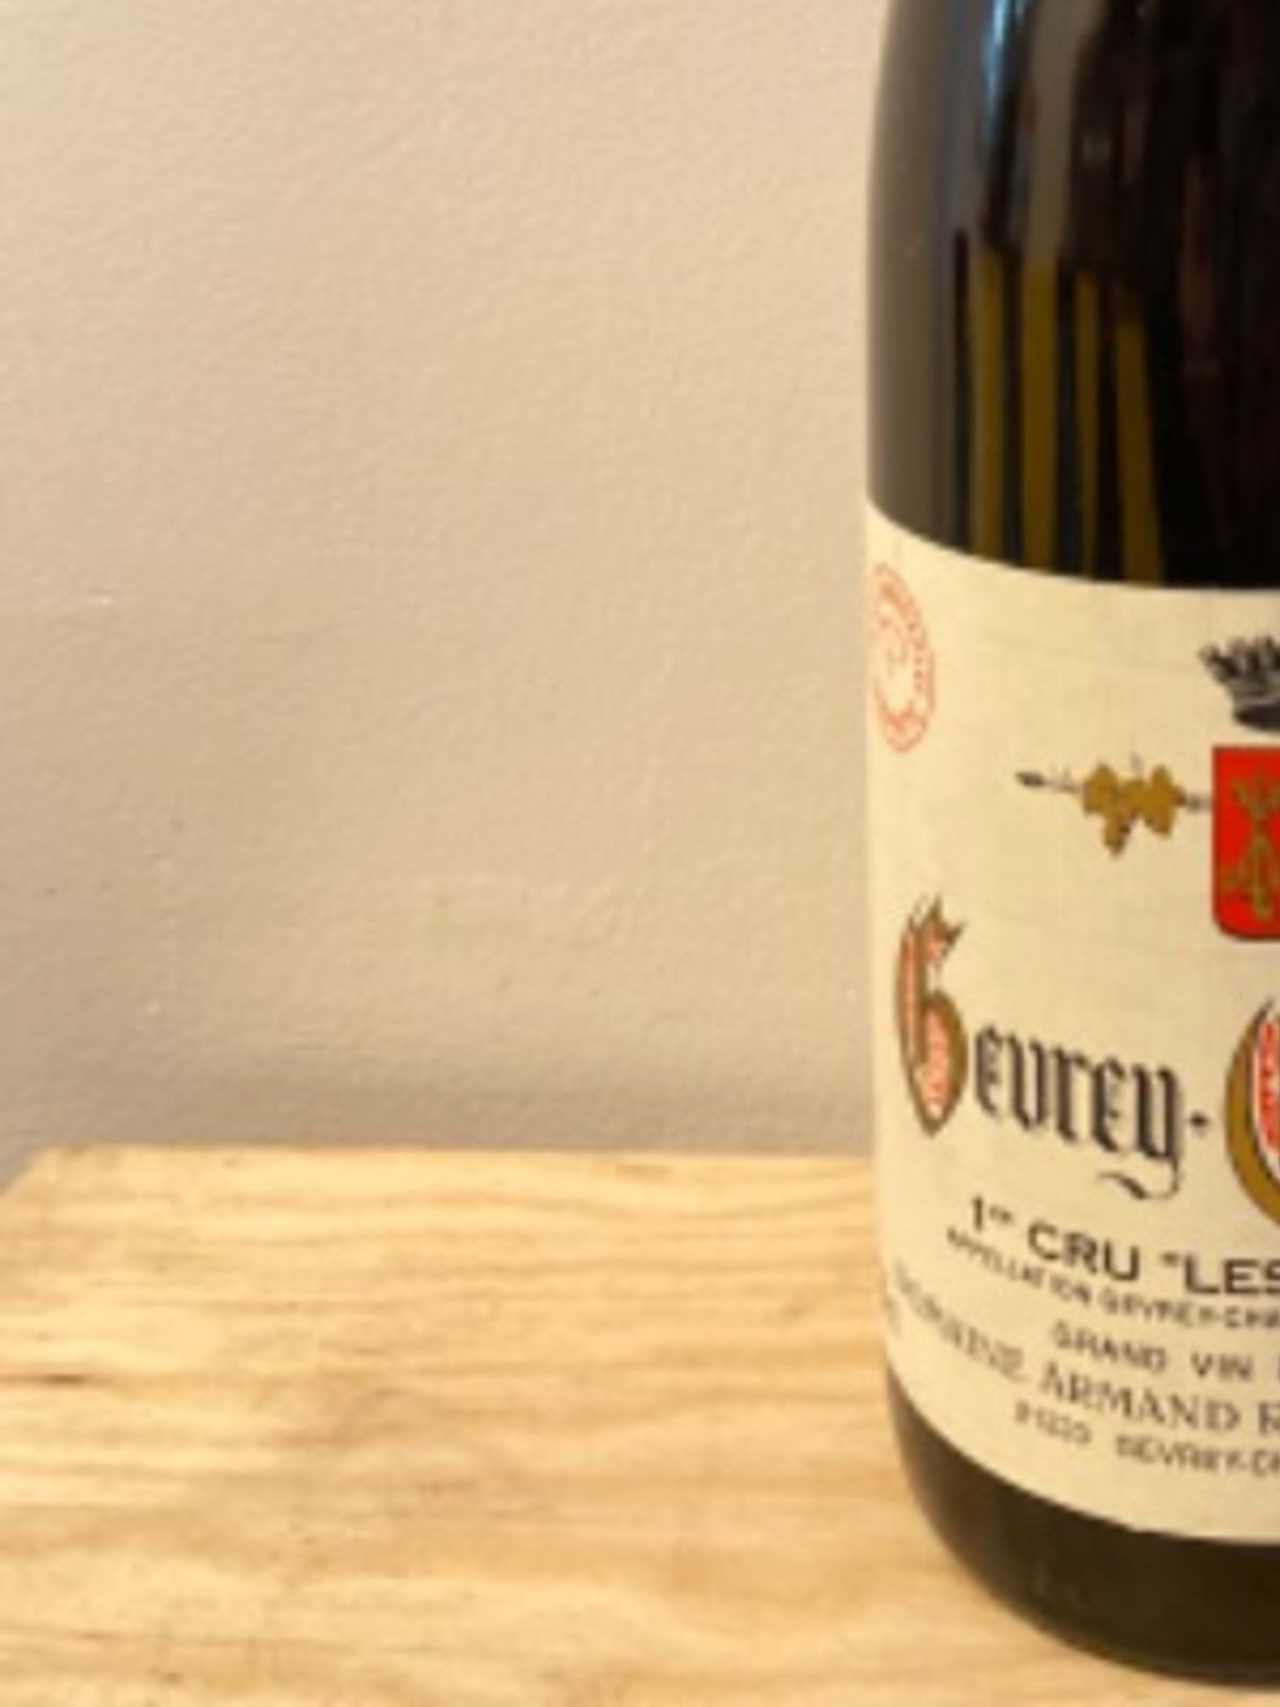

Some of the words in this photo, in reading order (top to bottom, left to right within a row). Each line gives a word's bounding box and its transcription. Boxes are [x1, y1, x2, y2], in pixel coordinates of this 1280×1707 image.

[1027, 1220, 1139, 1281] CRU
[1053, 1319, 1167, 1374] GRAND
[1191, 1350, 1254, 1382] VIN
[1038, 1360, 1241, 1436] ARMAND
